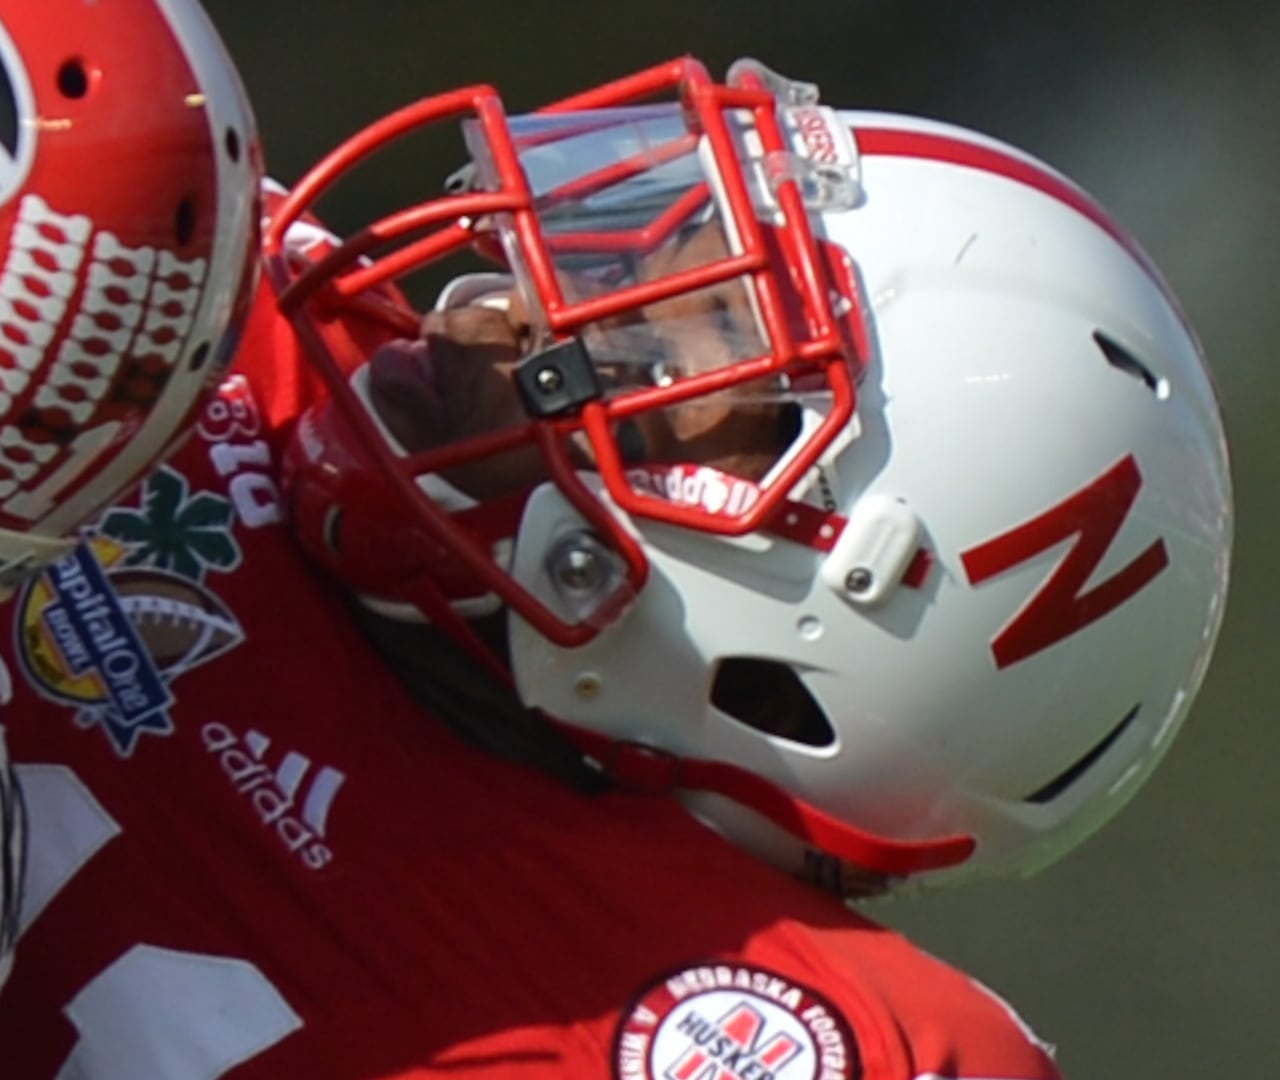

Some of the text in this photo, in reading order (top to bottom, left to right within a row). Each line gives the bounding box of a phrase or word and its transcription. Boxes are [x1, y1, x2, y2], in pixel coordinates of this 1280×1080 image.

[959, 452, 1170, 671] N
[46, 606, 90, 668] BOWL
[54, 552, 150, 713] apitalOne
[201, 722, 333, 870] adidas
[631, 1004, 659, 1026] A
[665, 966, 803, 1009] NEBRASKA
